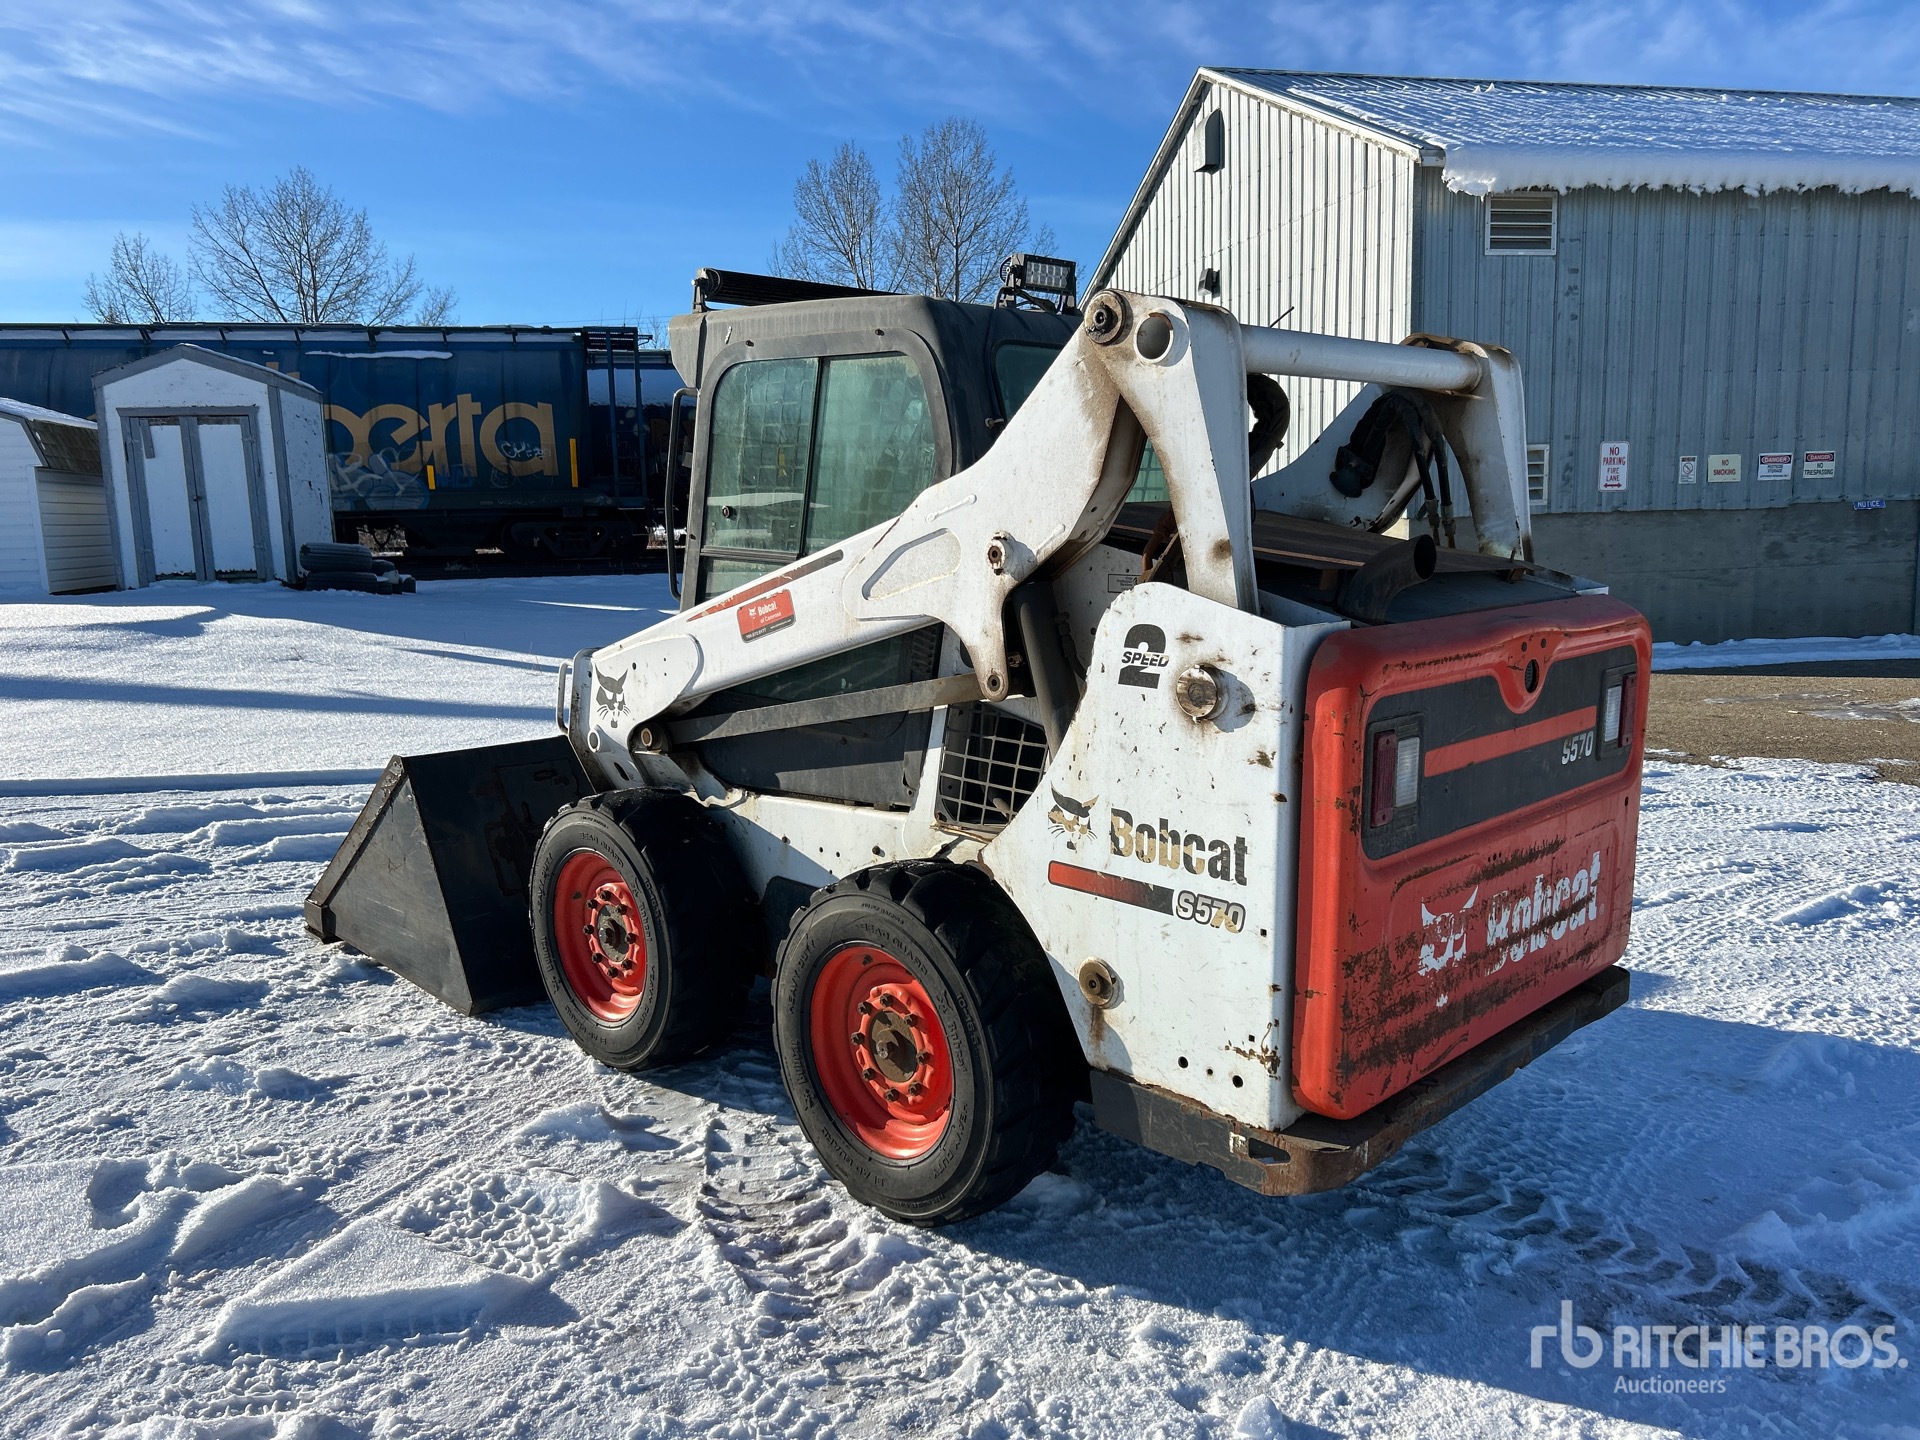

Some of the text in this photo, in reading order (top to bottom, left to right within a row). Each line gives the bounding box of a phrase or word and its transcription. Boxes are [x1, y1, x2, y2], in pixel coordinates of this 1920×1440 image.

[1609, 446, 1620, 456] NO
[1603, 456, 1626, 466] PARKING
[1764, 455, 1788, 463] DANGER
[1607, 467, 1620, 475] FIRE
[1712, 468, 1736, 476] SMOKING
[1804, 468, 1834, 476] TRESPASSING
[1857, 500, 1880, 508] NOTICE
[758, 601, 777, 616] Bobcat
[1120, 650, 1170, 668] SPEED
[1561, 730, 1594, 765] S570
[1110, 807, 1249, 887] Bobcat
[1176, 889, 1248, 934] S570
